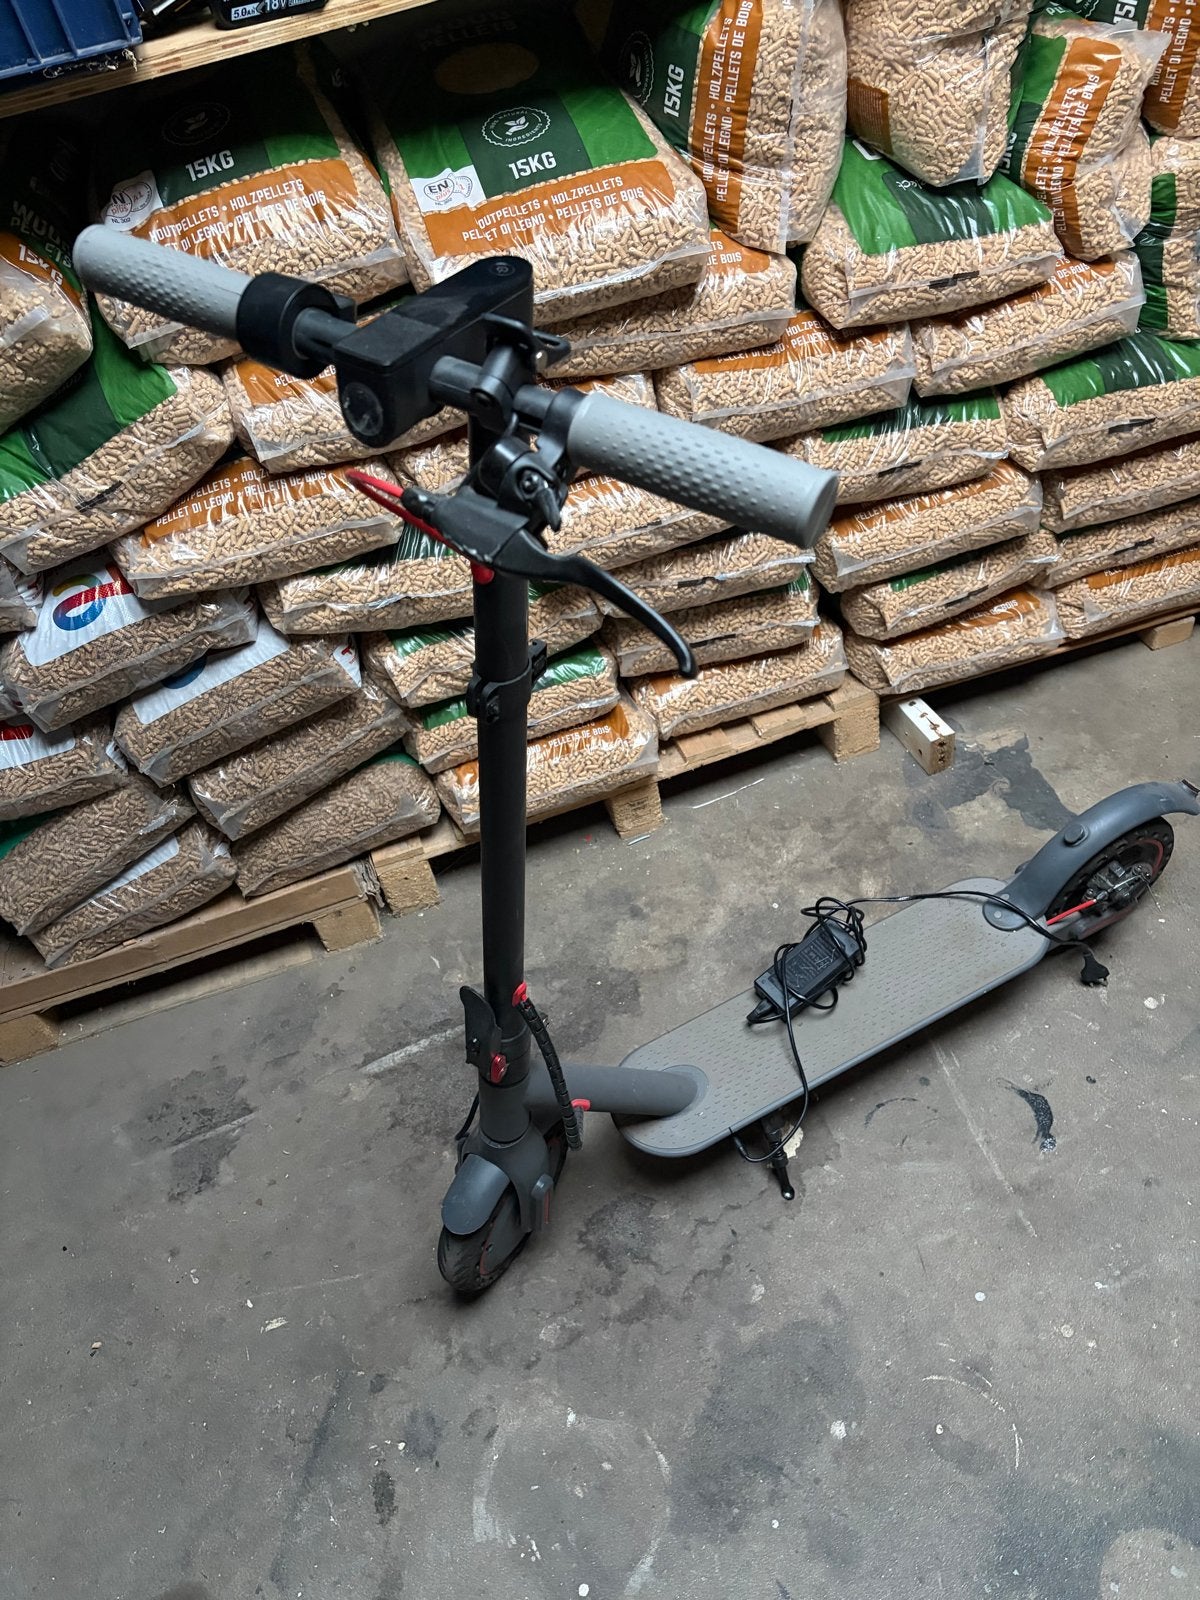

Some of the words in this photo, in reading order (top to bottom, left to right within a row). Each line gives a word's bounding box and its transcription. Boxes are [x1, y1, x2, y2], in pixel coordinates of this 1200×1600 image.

[736, 1, 753, 27] BOIS
[732, 30, 745, 48] DE
[1172, 18, 1192, 51] LEGNO
[708, 17, 733, 100] HOLZPELLETS
[1169, 52, 1181, 65] DI
[664, 63, 685, 118] 15KG
[724, 50, 742, 103] PELLETS
[1160, 67, 1178, 103] PELLET
[1074, 103, 1089, 116] DE
[719, 115, 733, 152] LEGNO
[185, 150, 235, 182] 15KG
[508, 151, 557, 180] 15KG
[428, 180, 449, 194] EN
[551, 176, 623, 205] HOLZPELLETS
[149, 205, 219, 244] HOUTPELLETS
[229, 179, 304, 211] HOLZPELLETS
[500, 222, 511, 236] DI
[514, 213, 546, 232] LEGNO
[555, 198, 602, 220] PELLETS
[603, 193, 619, 207] DE
[620, 187, 644, 202] BOIS
[181, 239, 192, 251] DI
[192, 222, 225, 244] LEGNO
[720, 251, 742, 264] BOIS
[589, 477, 599, 487] DI
[156, 505, 189, 527] PELLET
[191, 501, 202, 514] DI
[204, 492, 234, 510] LEGNO
[549, 732, 580, 748] PELLETS
[593, 725, 611, 736] BOIS
